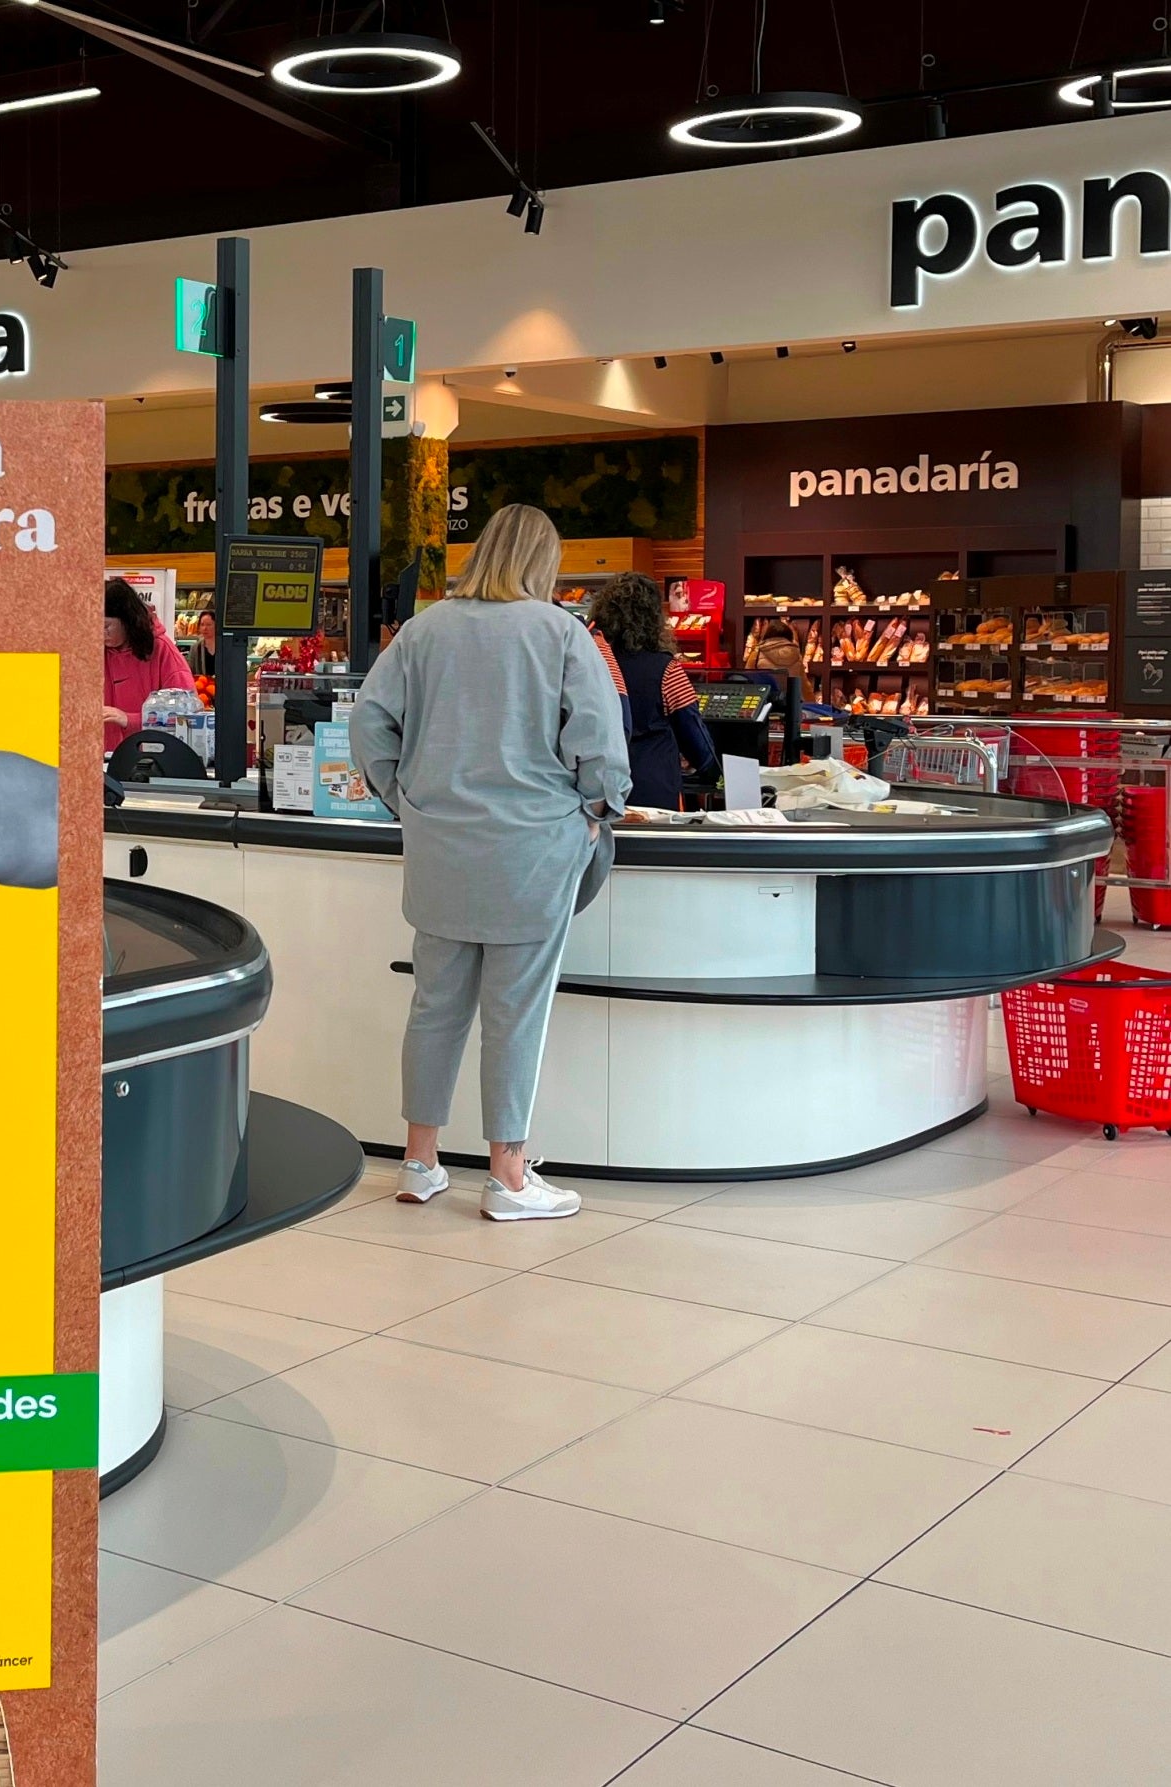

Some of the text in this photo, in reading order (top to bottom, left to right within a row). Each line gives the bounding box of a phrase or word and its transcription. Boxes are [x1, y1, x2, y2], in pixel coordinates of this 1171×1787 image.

[890, 169, 1171, 307] pan
[190, 299, 207, 336] 2
[393, 333, 406, 367] 1
[789, 450, 1019, 507] panadaría
[293, 494, 312, 518] e
[265, 584, 307, 599] GADIS
